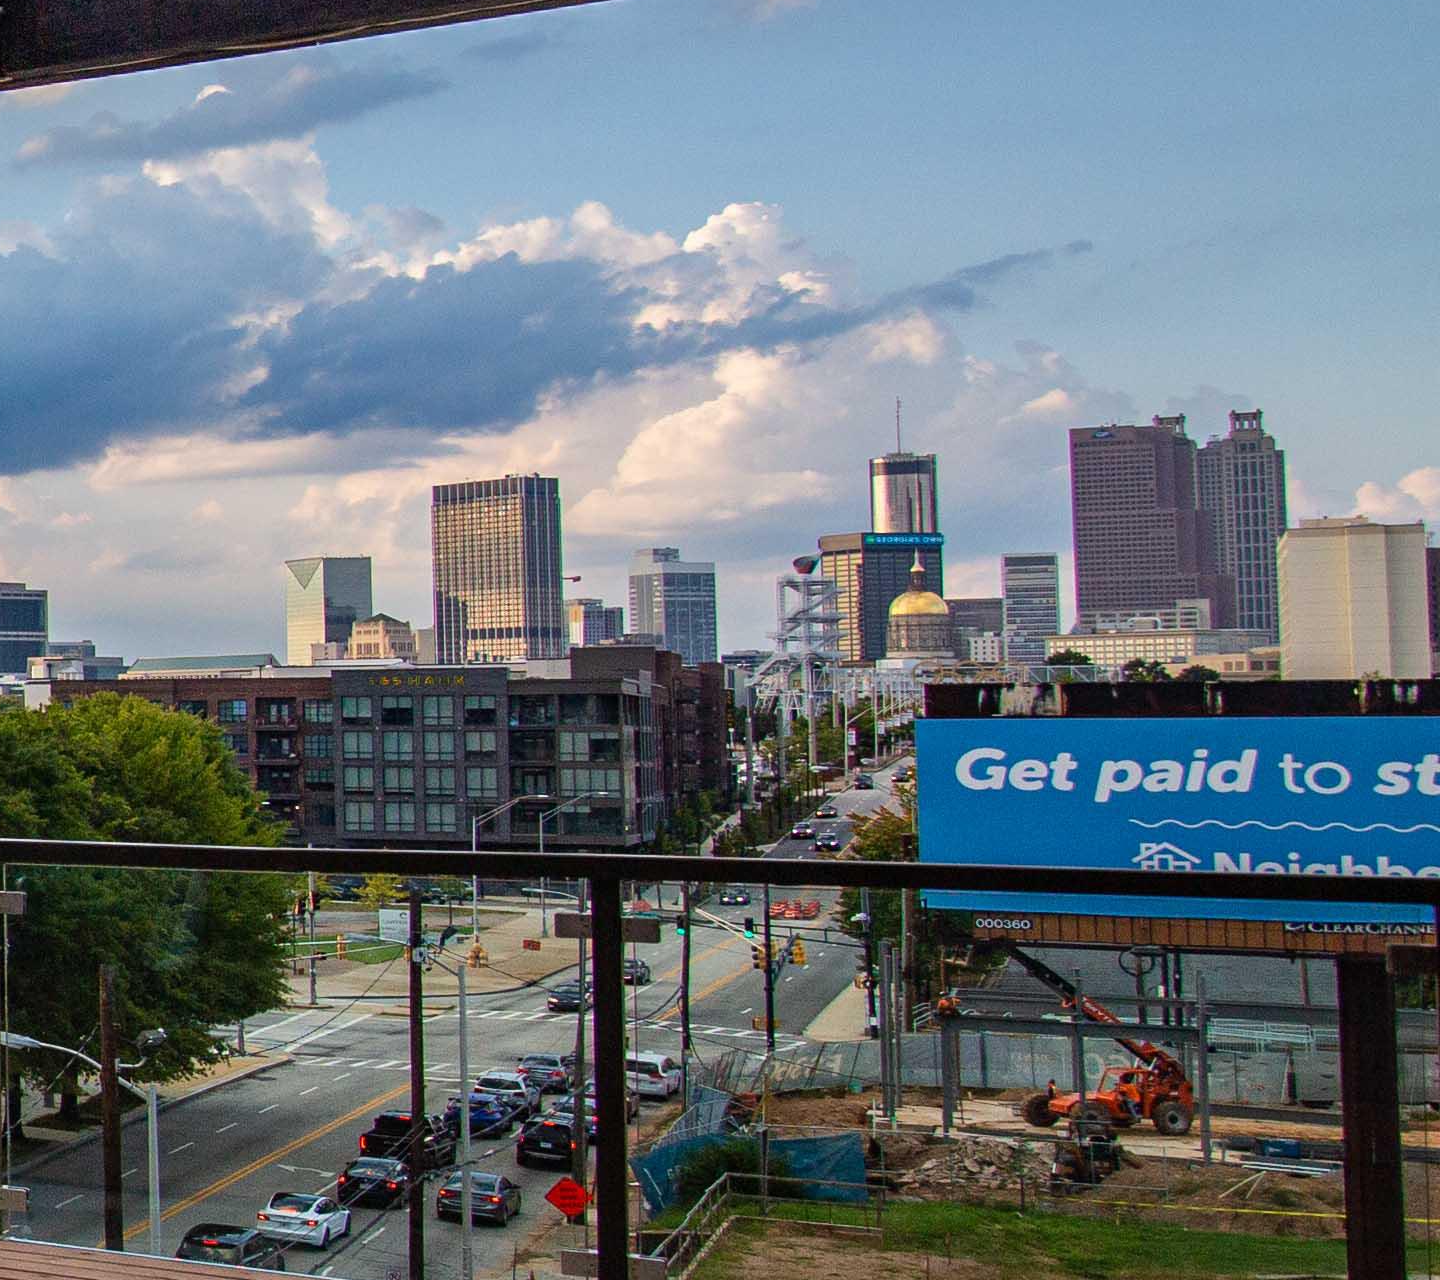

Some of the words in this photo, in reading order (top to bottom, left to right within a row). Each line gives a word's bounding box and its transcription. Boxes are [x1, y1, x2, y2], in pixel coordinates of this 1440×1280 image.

[955, 747, 1079, 792] Get
[1094, 748, 1258, 803] paid
[1278, 753, 1352, 795] to
[975, 918, 1031, 929] 000360
